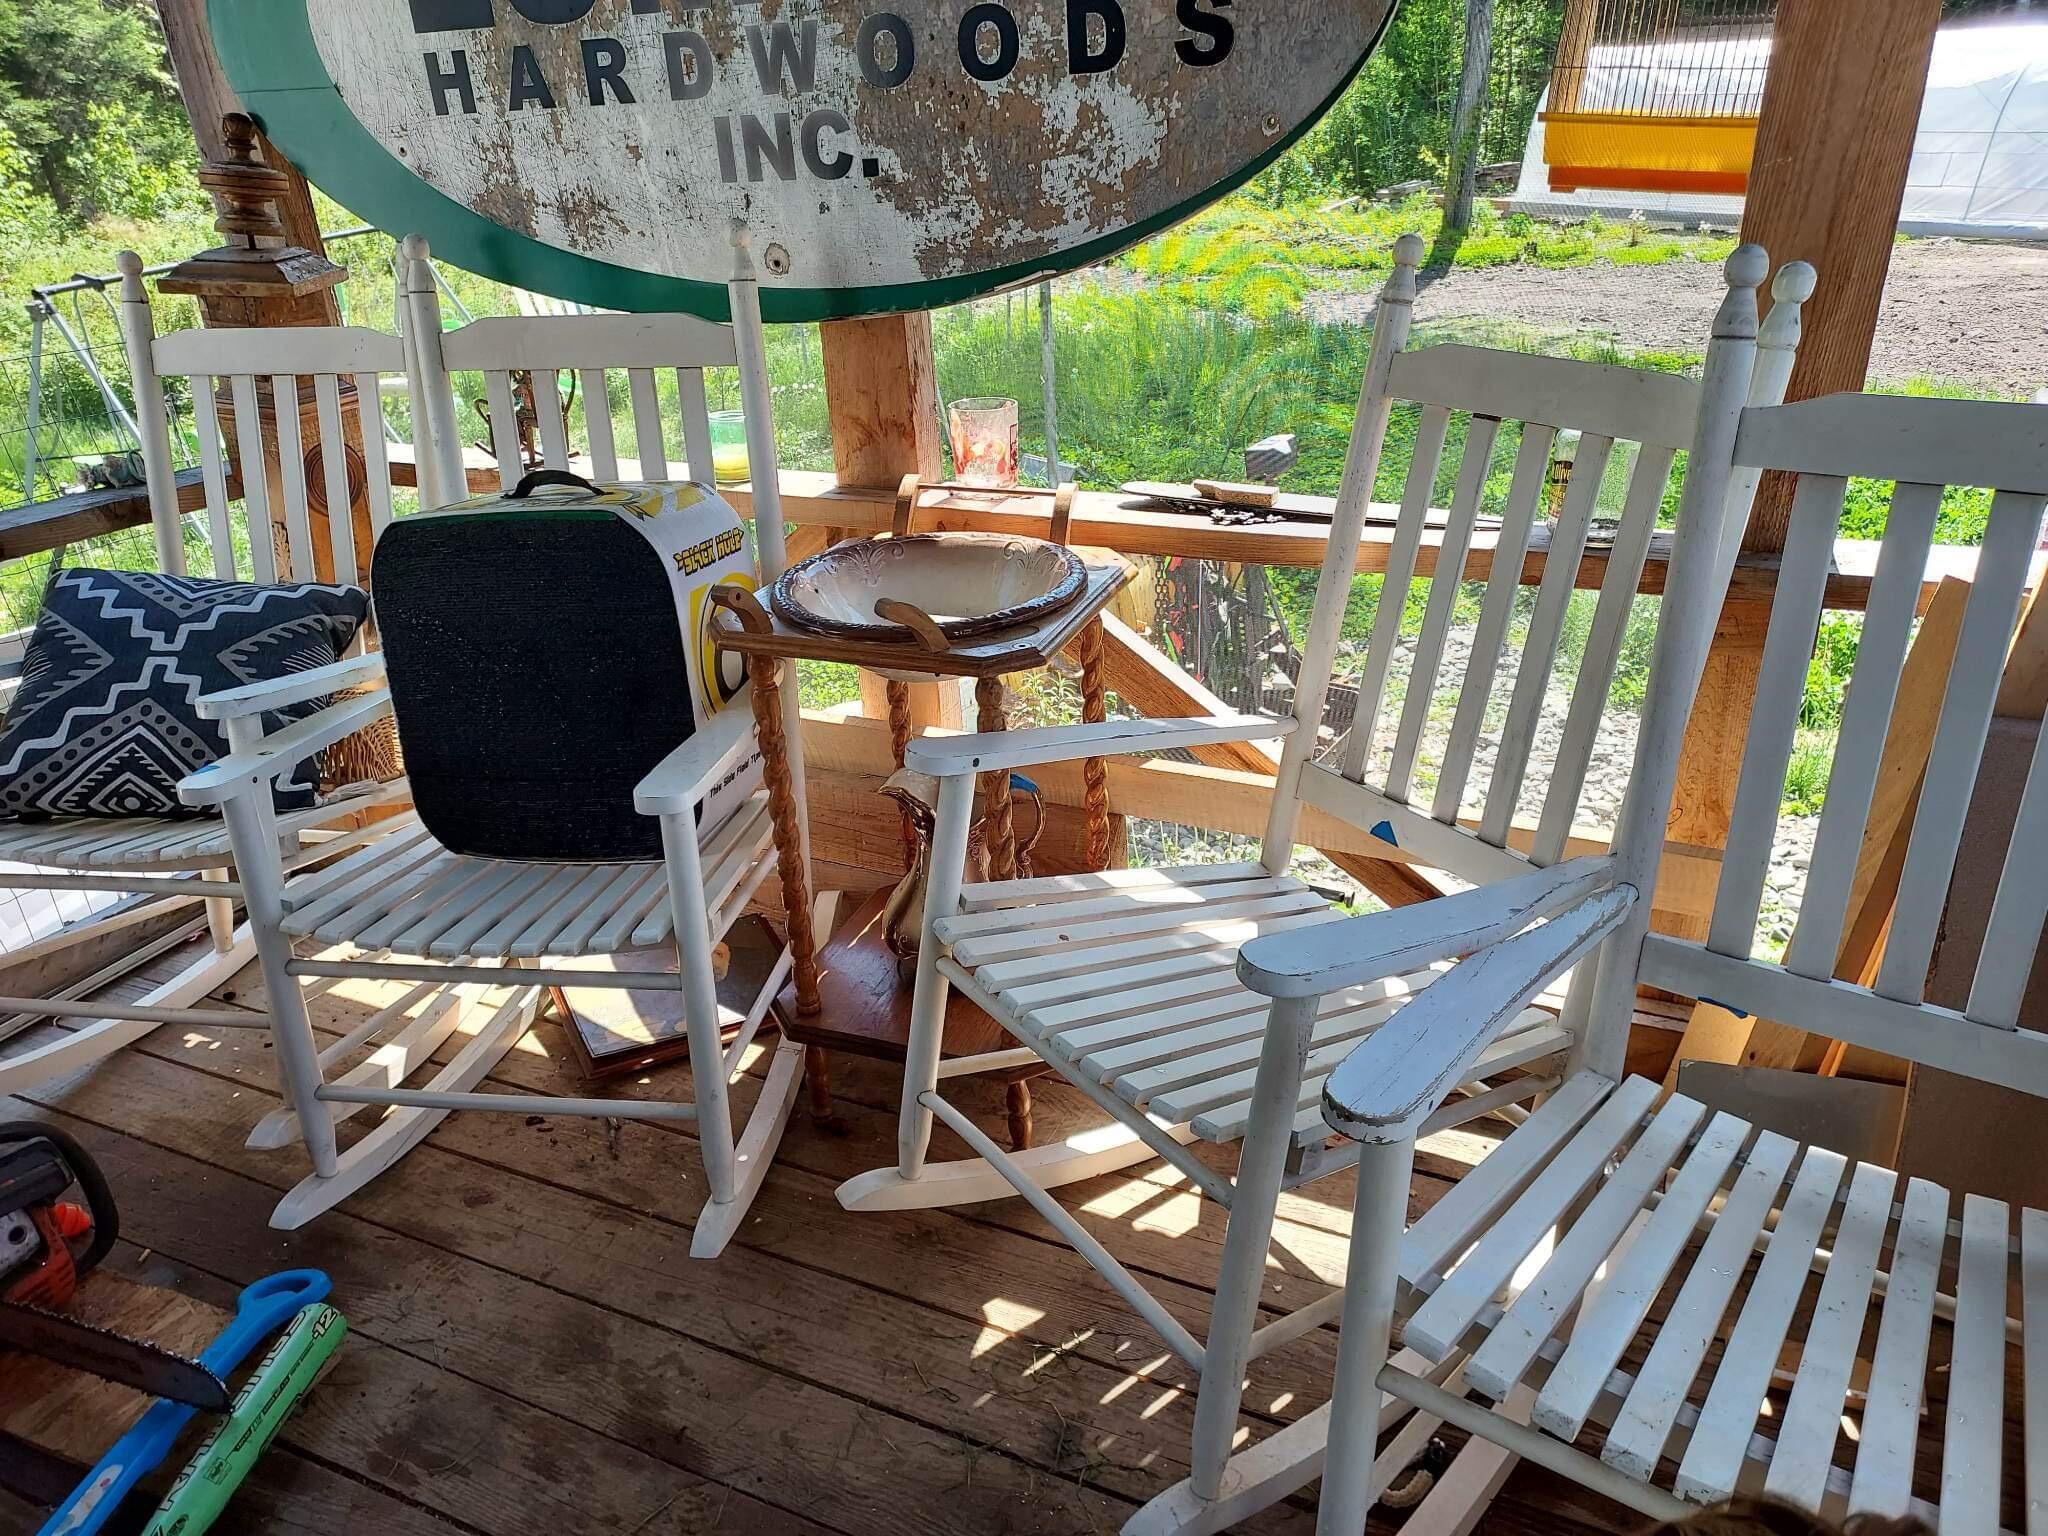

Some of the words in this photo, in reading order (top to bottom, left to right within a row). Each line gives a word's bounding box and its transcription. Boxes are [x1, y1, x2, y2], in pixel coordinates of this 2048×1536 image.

[424, 0, 1235, 116] HARDWOODS
[713, 110, 880, 184] INC.
[681, 538, 716, 577] BLACK
[715, 527, 742, 561] HOLE
